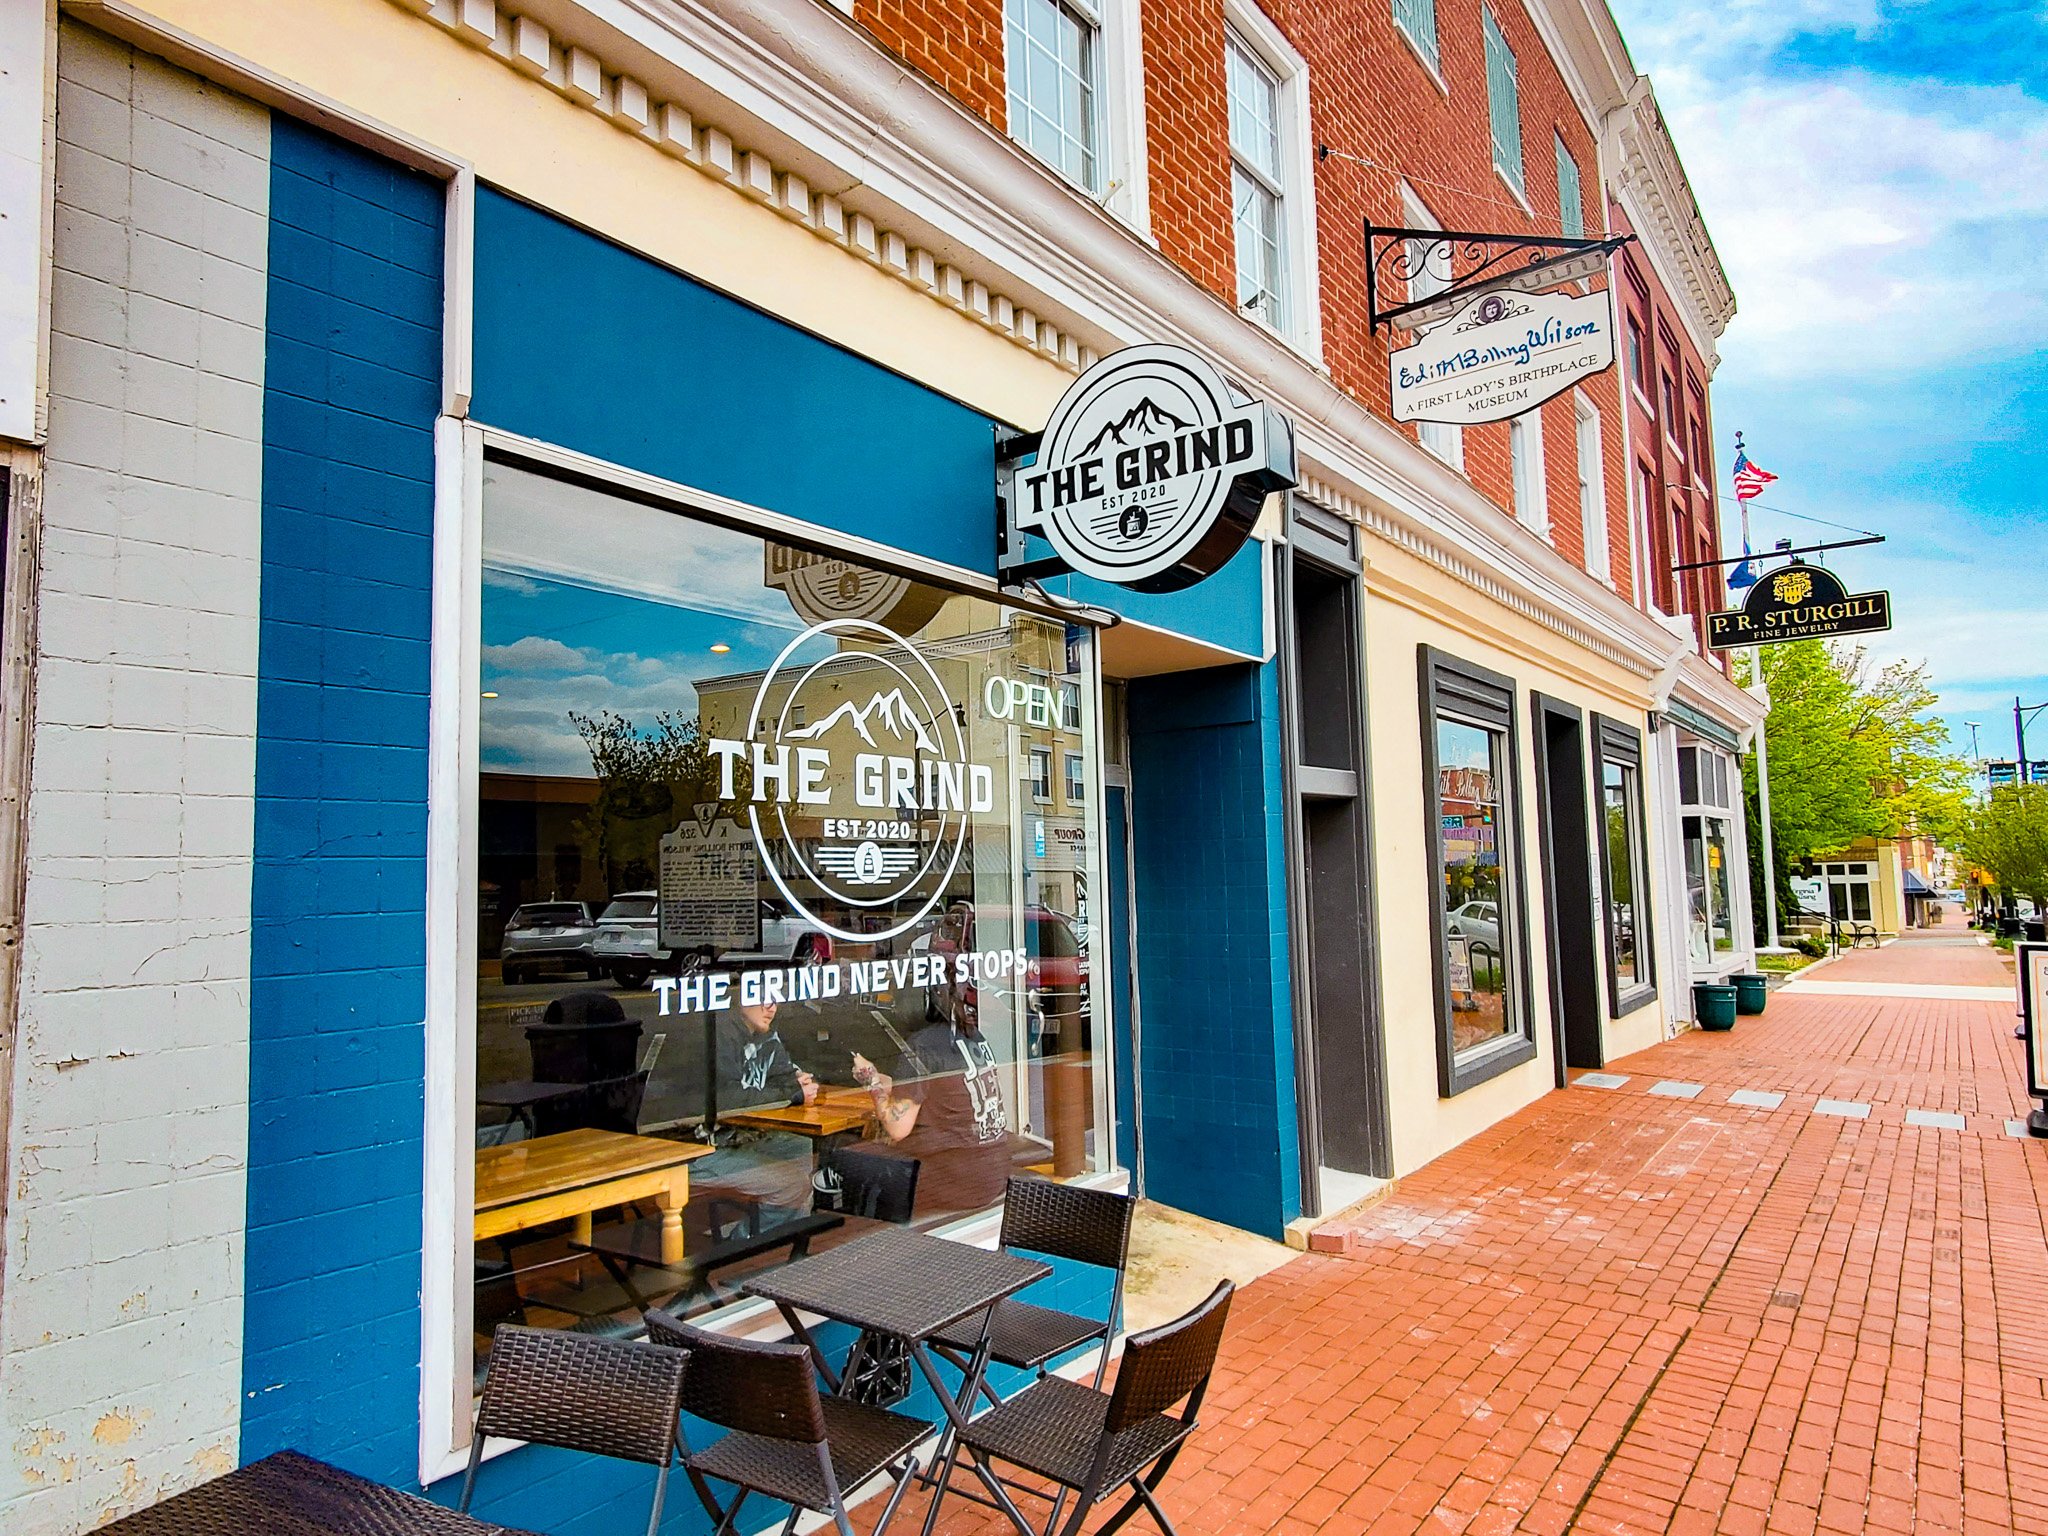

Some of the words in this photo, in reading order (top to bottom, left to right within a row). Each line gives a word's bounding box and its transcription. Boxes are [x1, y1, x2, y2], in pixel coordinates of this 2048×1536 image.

[1400, 353, 1462, 389] Edith
[1461, 342, 1530, 368] Bolling
[1526, 316, 1600, 347] Wilson
[1405, 404, 1415, 414] A
[1417, 393, 1451, 412] FIRST
[1456, 380, 1505, 401] LADY'S
[1509, 354, 1598, 389] BIRTHPLACE
[1468, 388, 1529, 413] MUSEUM
[1025, 457, 1105, 514] THE
[1115, 418, 1254, 491] GRIND
[1101, 494, 1125, 510] EST
[1131, 484, 1167, 504] 2020
[1714, 617, 1730, 634] P.
[1736, 615, 1759, 631] R.
[1764, 599, 1882, 628] STURGILL
[1753, 629, 1781, 640] FINE
[1785, 622, 1839, 637] JEWELRY
[985, 675, 1064, 730] OPEN
[707, 738, 833, 805] THE
[855, 752, 994, 813] GRIND
[823, 818, 860, 839] EST
[865, 820, 911, 840] 2020
[652, 974, 732, 1017] THE
[741, 964, 841, 1009] GRIND
[850, 955, 948, 994] NEVER
[955, 948, 1028, 982] STOPS
